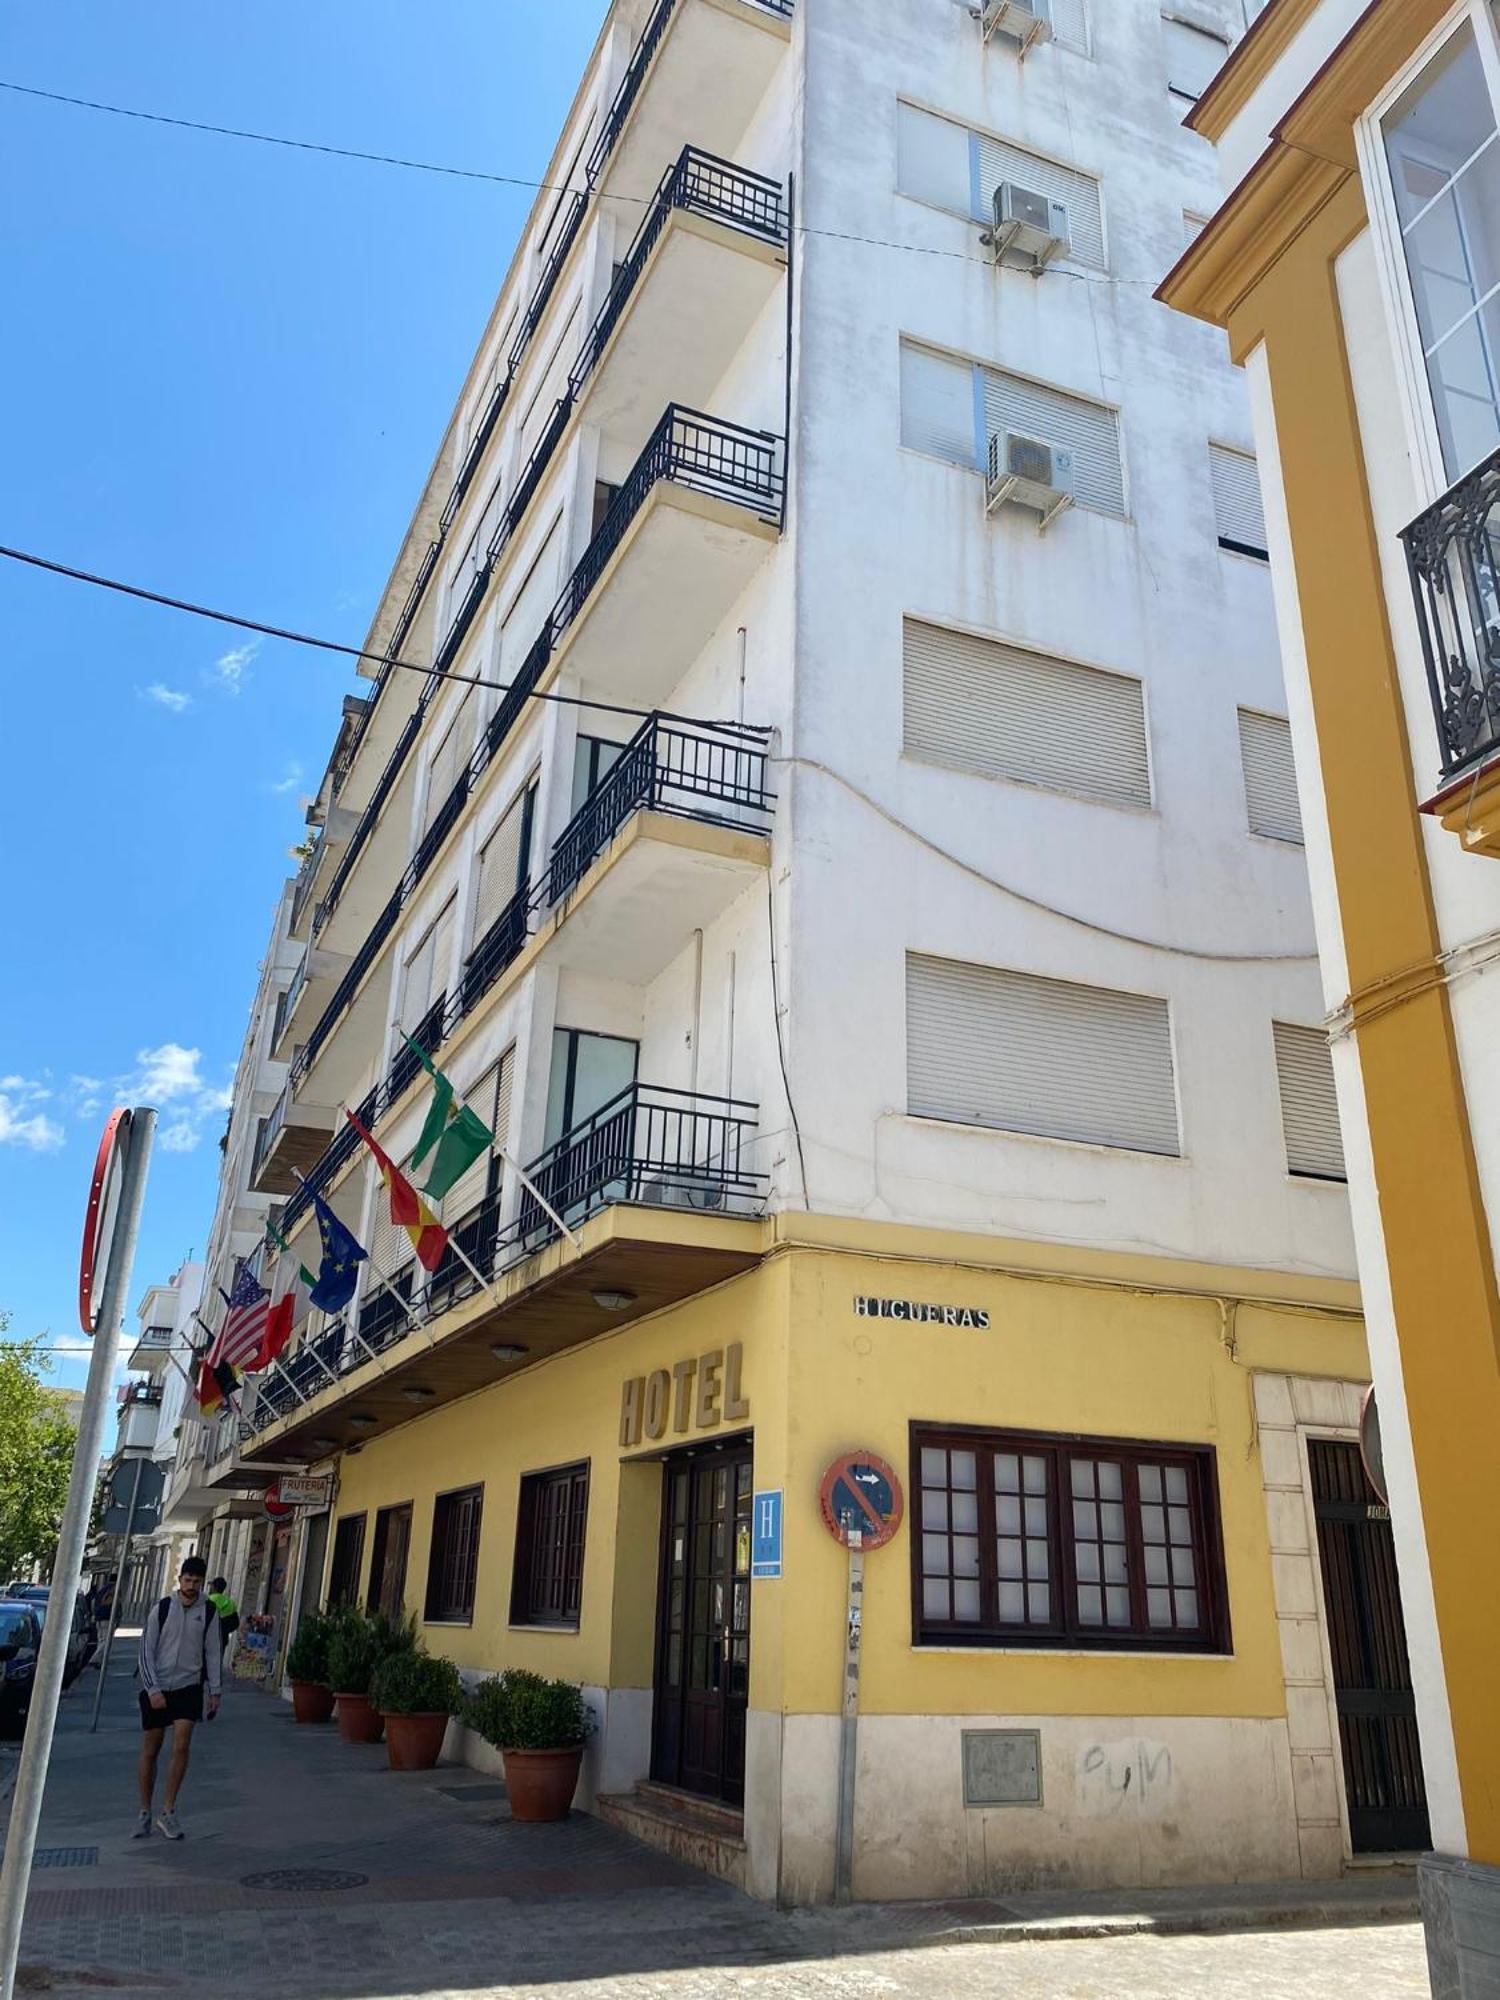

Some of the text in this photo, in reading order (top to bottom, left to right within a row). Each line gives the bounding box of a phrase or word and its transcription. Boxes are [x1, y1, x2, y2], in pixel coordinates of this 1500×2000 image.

[854, 1297, 989, 1328] HIGUERAS
[619, 1342, 749, 1446] HOTEL
[761, 1500, 774, 1538] H
